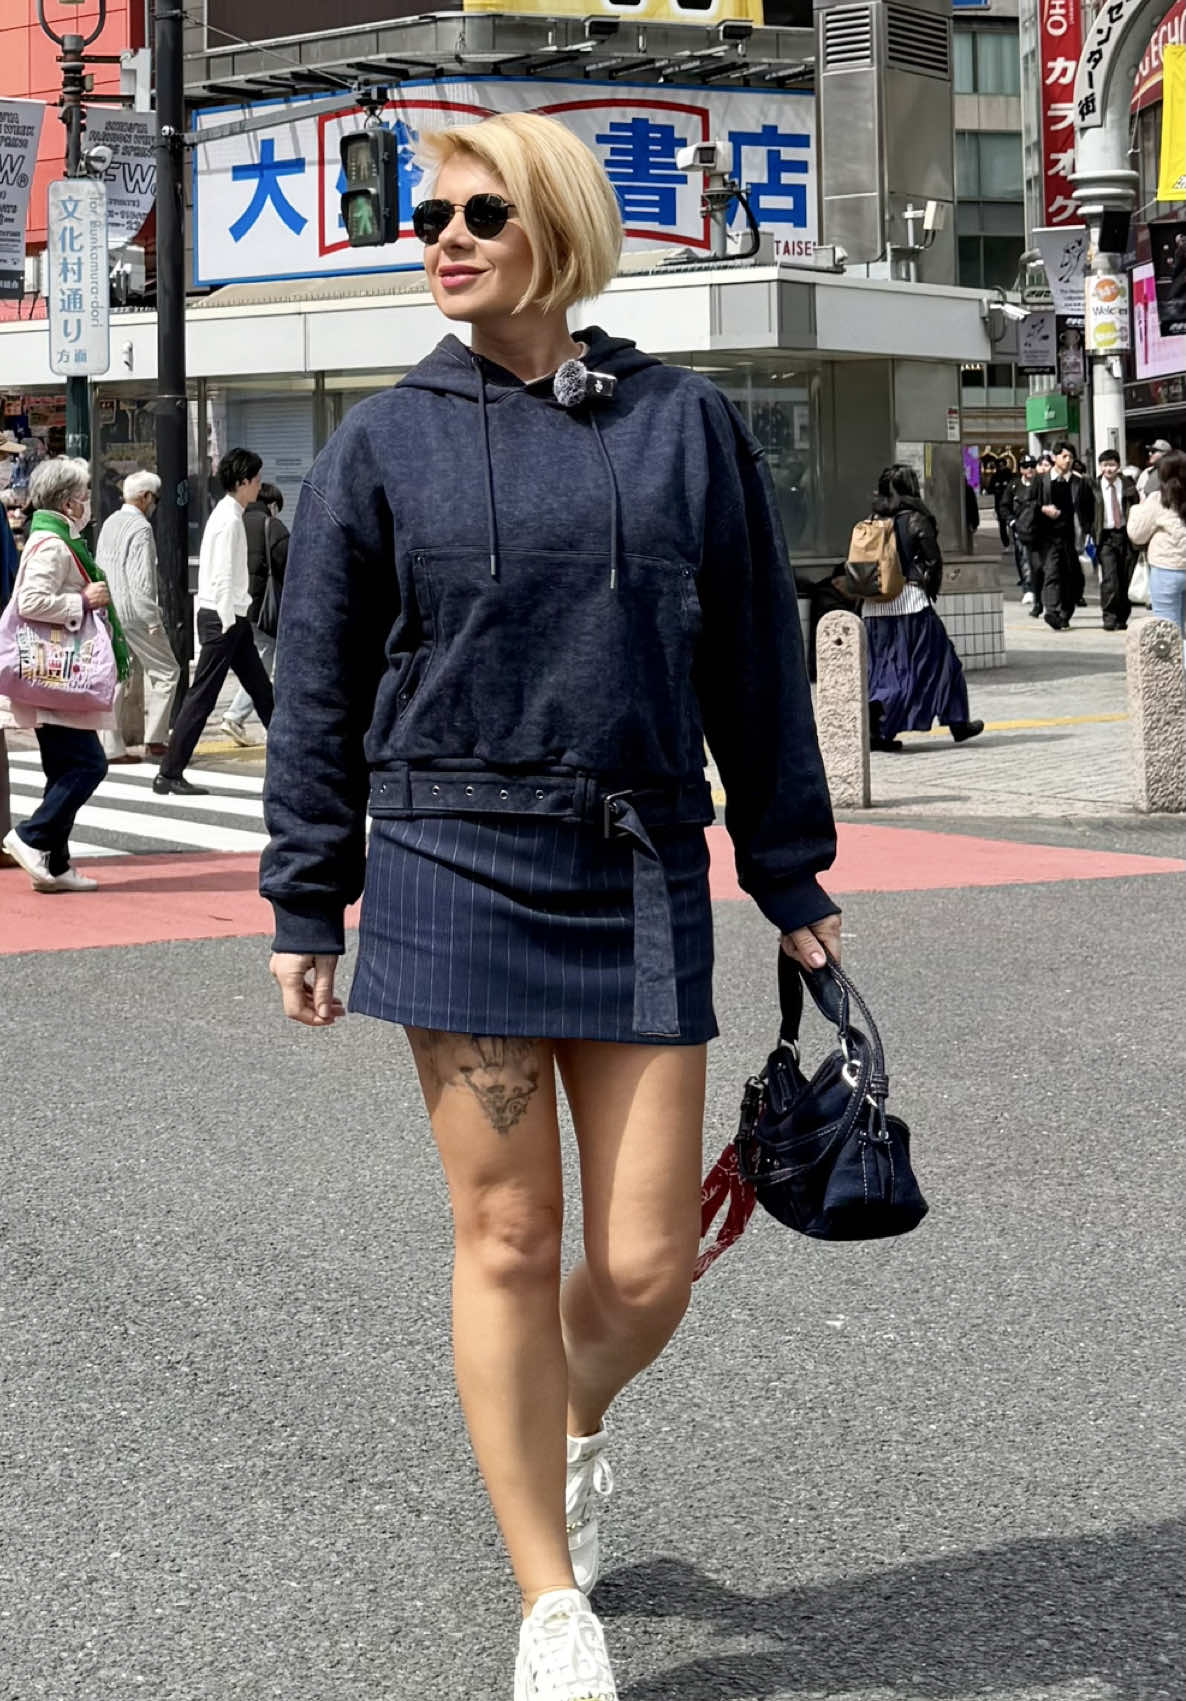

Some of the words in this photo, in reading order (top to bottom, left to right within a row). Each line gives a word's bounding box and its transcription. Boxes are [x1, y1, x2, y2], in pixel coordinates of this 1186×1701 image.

[58, 195, 86, 344] 文化村通り
[57, 349, 88, 364] 方面
